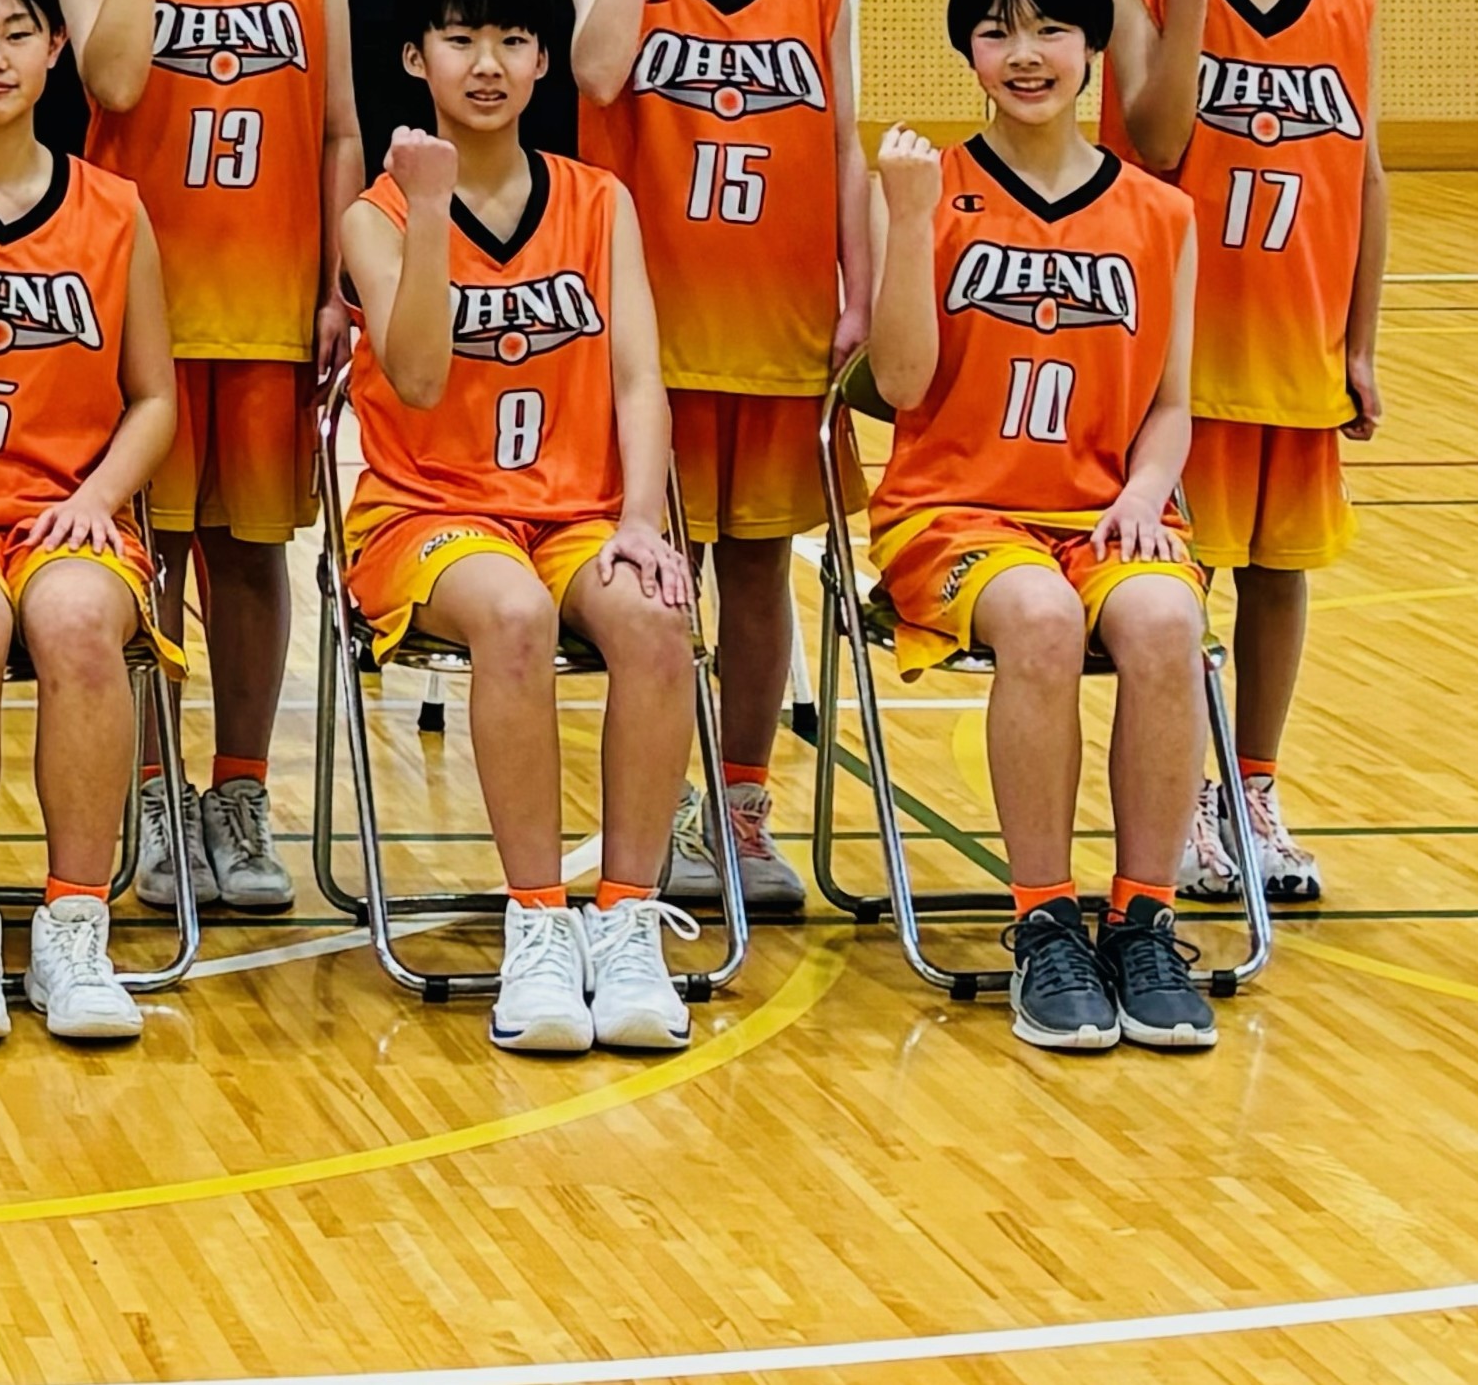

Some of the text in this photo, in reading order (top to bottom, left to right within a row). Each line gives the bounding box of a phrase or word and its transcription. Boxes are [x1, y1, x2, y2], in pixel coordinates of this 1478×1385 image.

[633, 29, 828, 112] OHNO
[184, 108, 263, 188] 13
[686, 142, 771, 225] 15
[1222, 167, 1302, 252] 17
[450, 270, 605, 341] HNO
[944, 241, 1138, 335] OHNO
[495, 388, 545, 471] 8
[1000, 358, 1076, 443] 10
